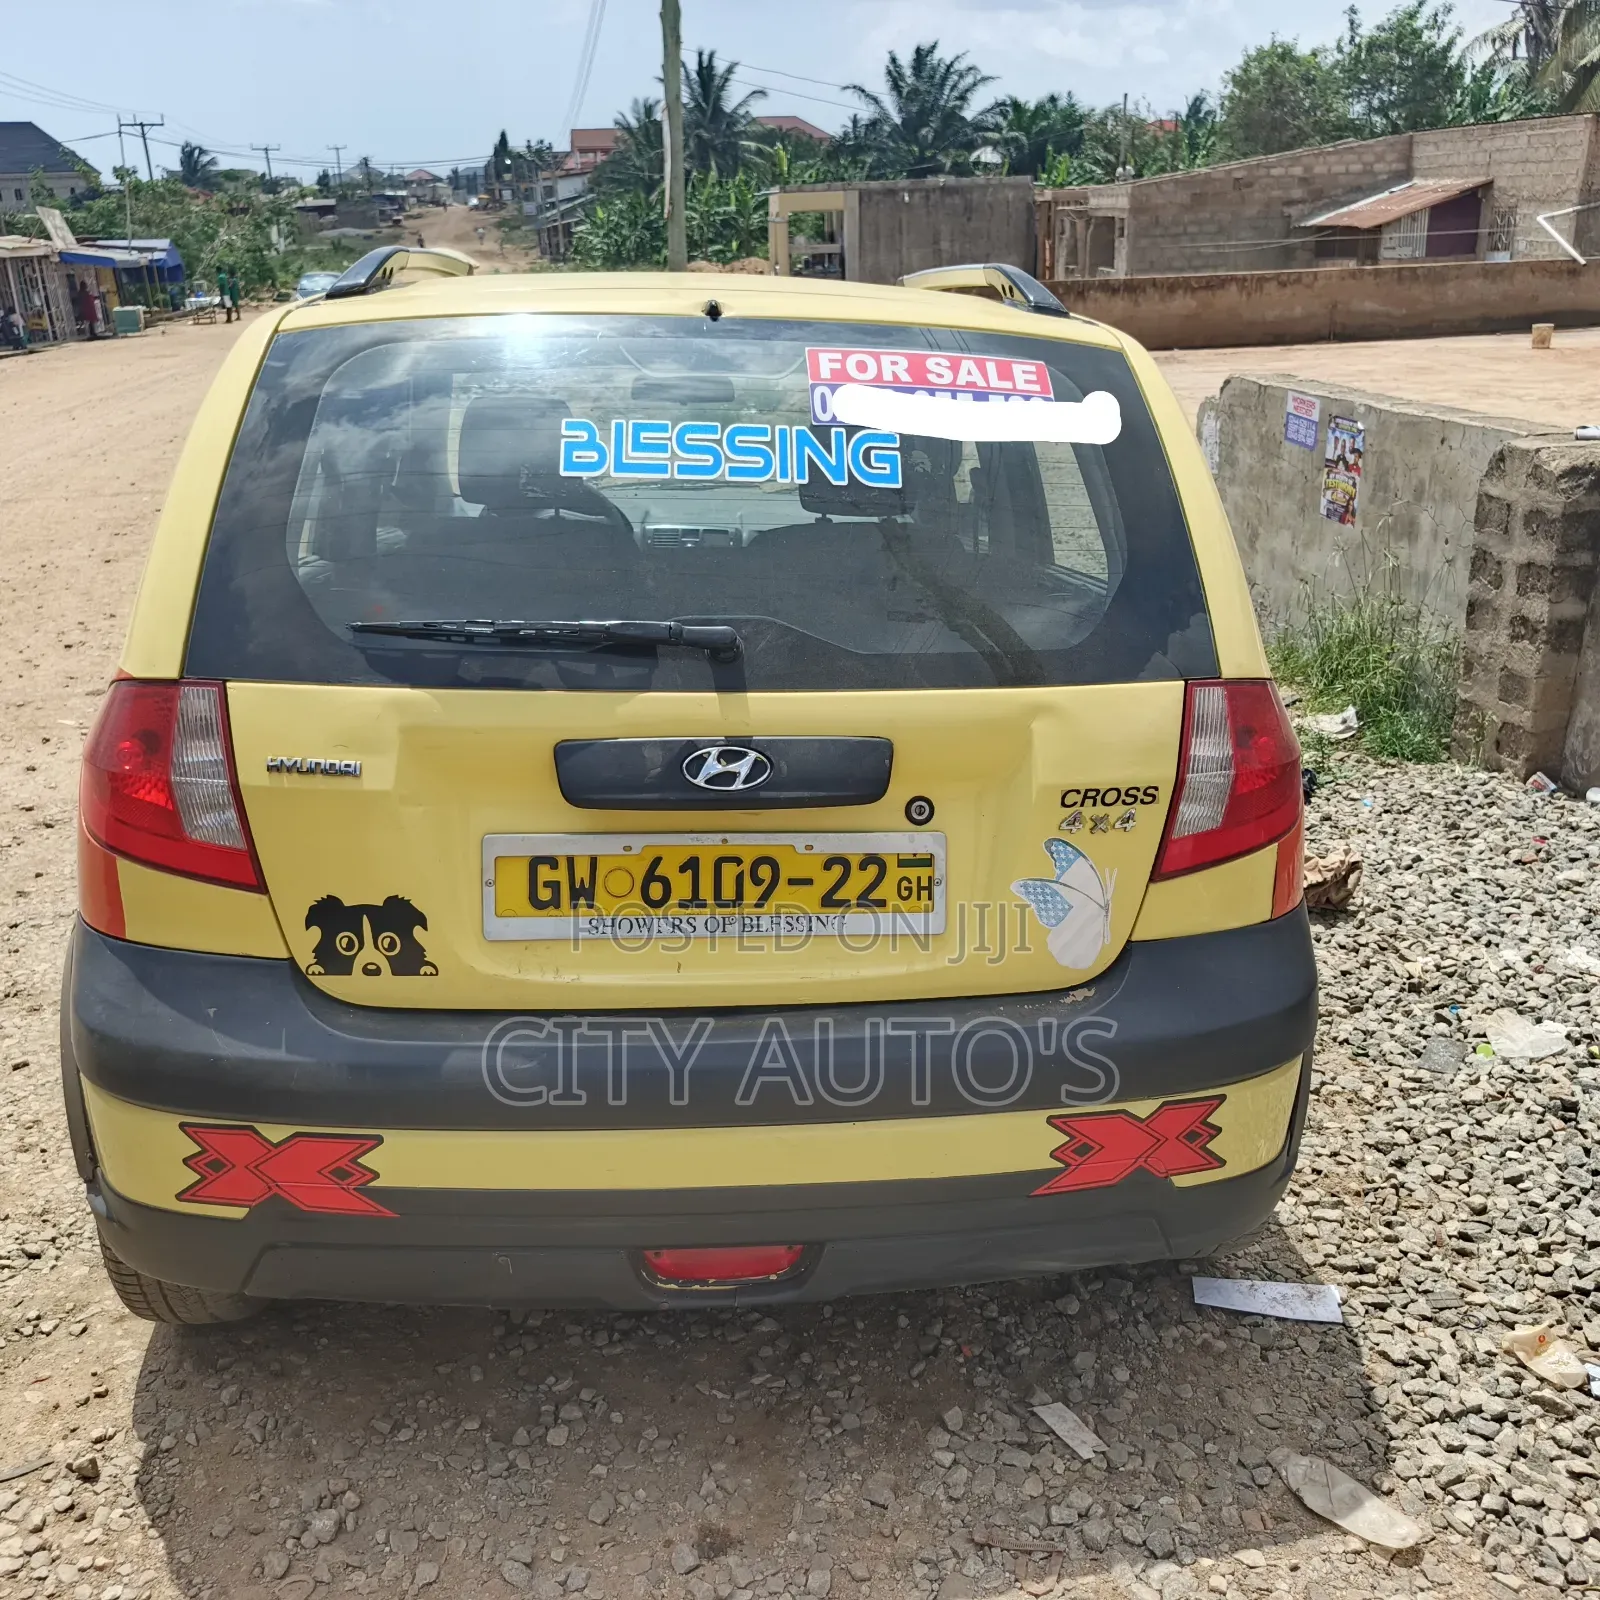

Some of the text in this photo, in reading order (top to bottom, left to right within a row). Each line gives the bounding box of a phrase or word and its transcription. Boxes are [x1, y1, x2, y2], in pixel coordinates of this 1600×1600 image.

[818, 352, 1042, 392] FOR SALE
[1291, 396, 1316, 410] WORKERS
[1293, 405, 1313, 418] NEEDED
[560, 419, 902, 488] BLESSING
[266, 756, 362, 777] HYUNDAI
[1060, 786, 1159, 808] CROSS
[528, 856, 598, 911] GW
[897, 876, 932, 901] GH
[588, 914, 846, 936] SHOWERS OF BLESSING
